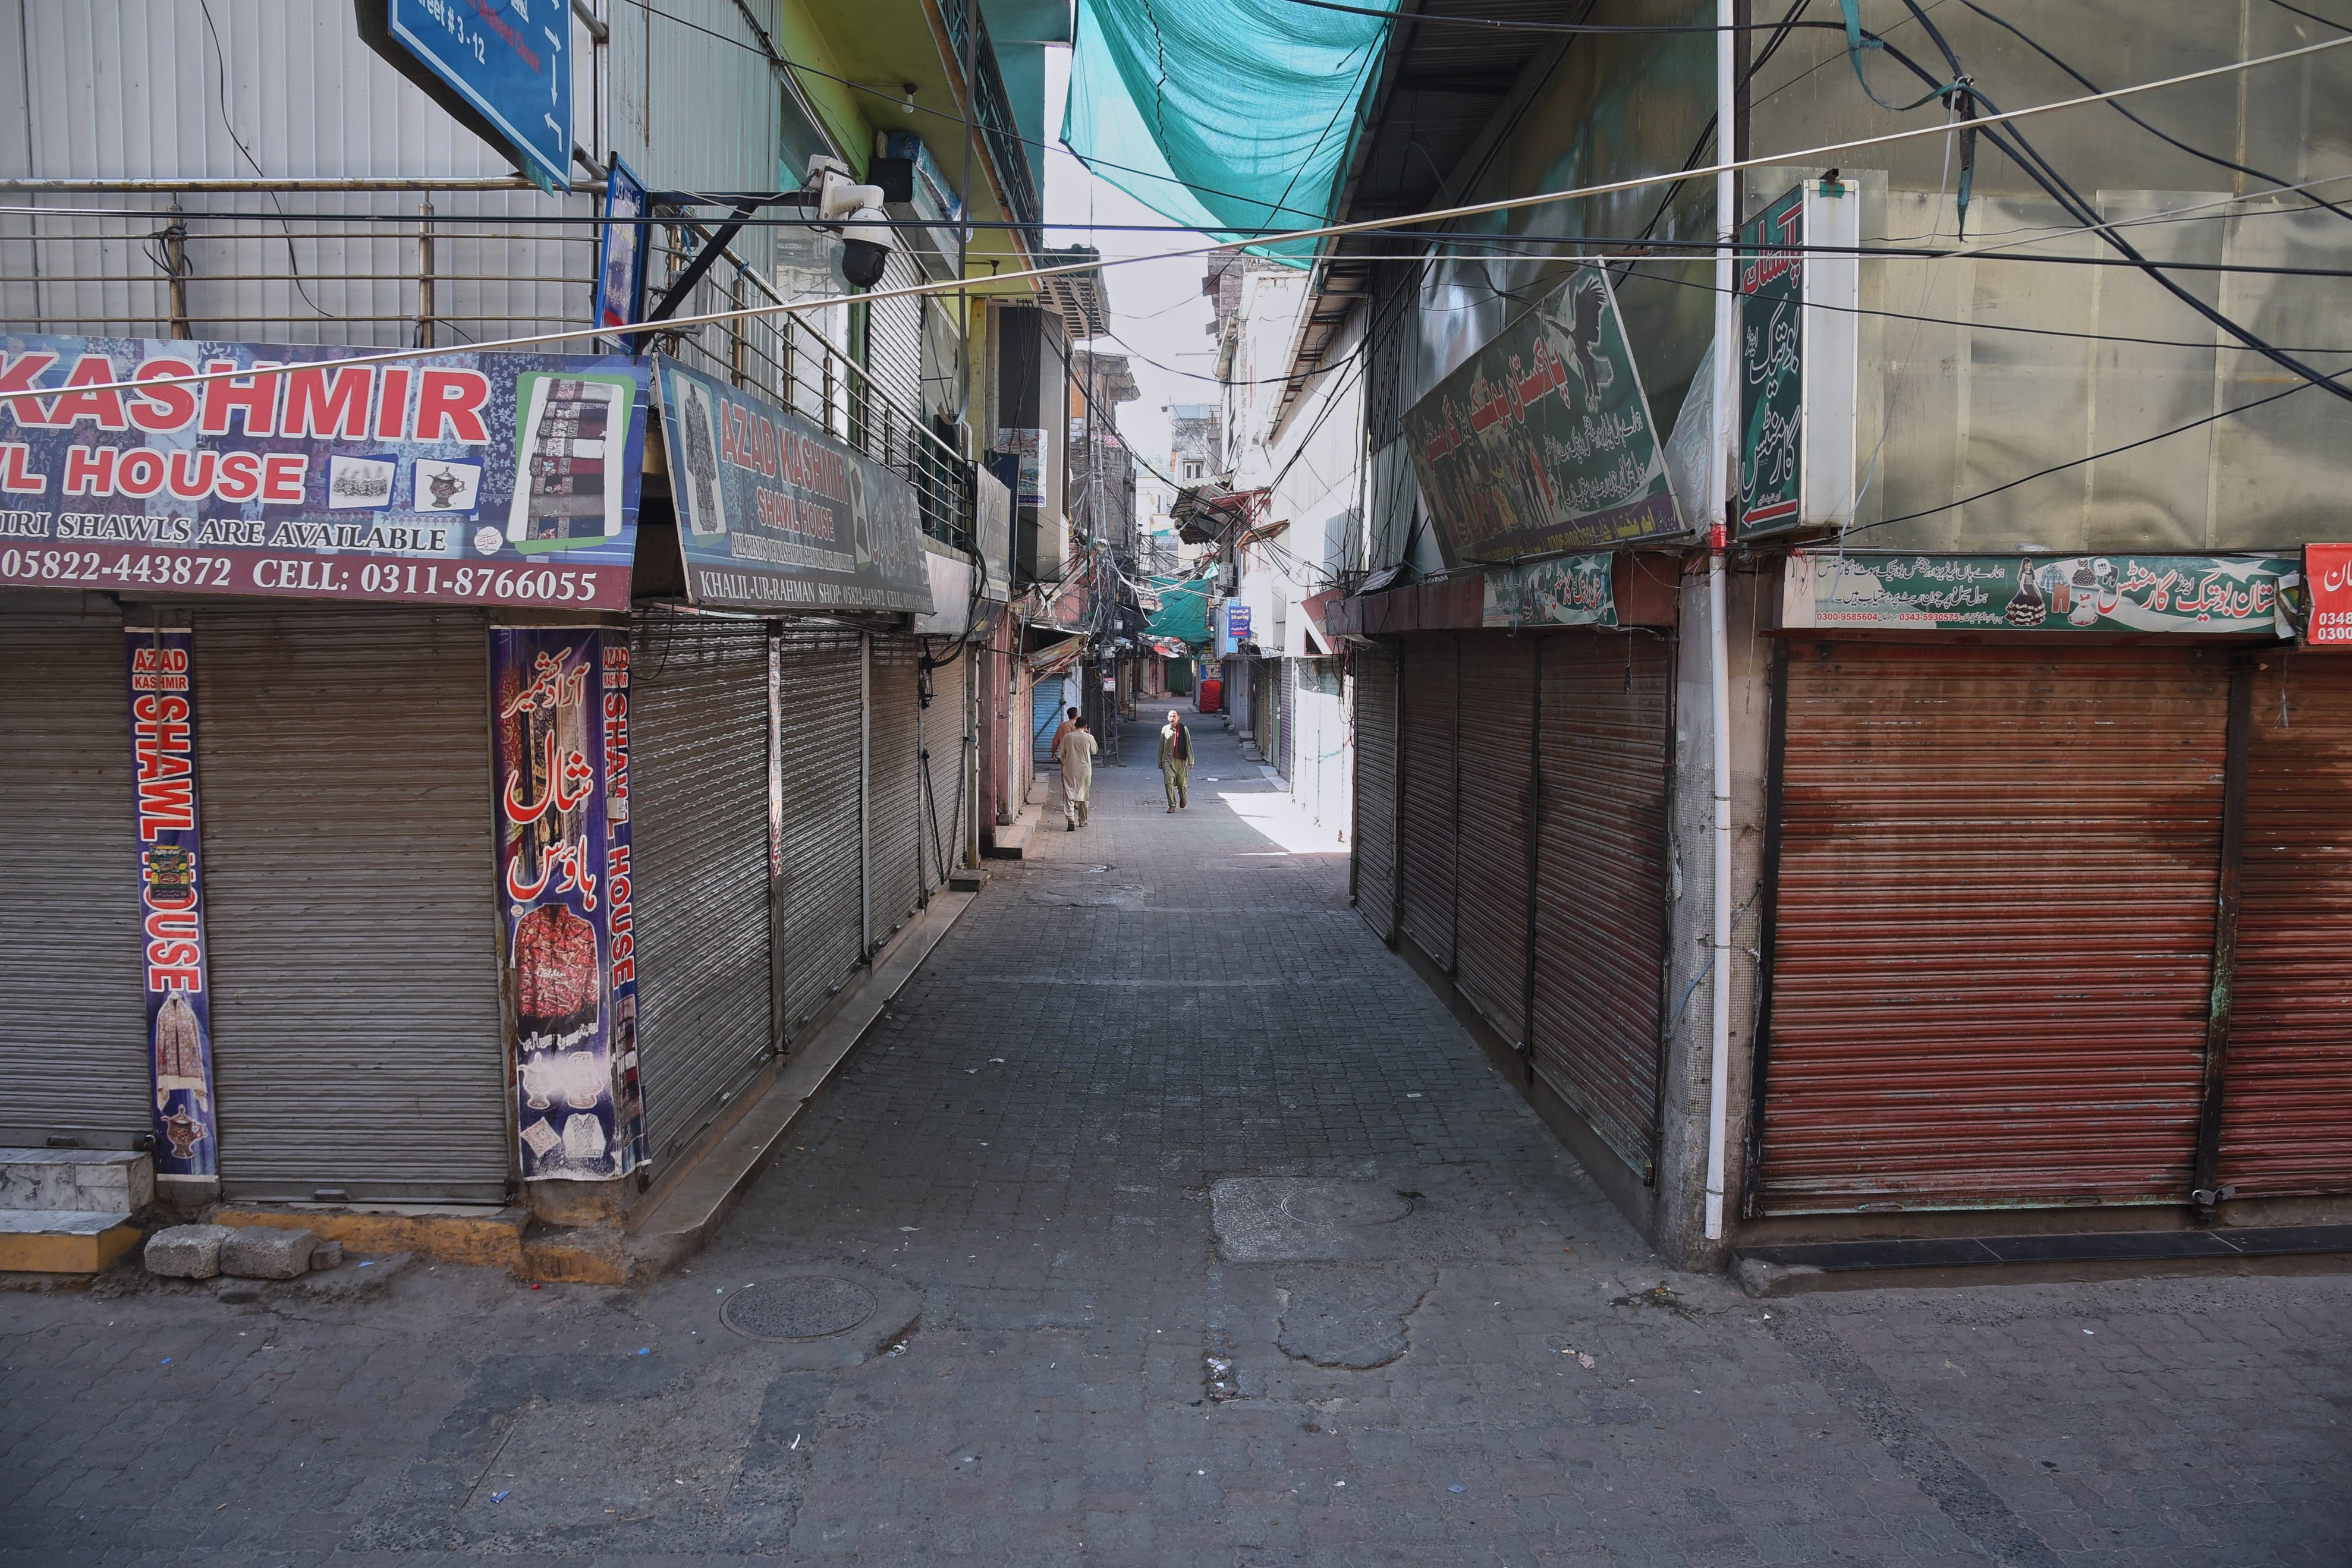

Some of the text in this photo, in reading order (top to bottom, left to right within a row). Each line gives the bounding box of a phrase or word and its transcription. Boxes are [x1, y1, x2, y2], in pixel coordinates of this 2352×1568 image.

[457, 15, 464, 43] 3
[472, 32, 485, 65] 12
[1750, 292, 1800, 398] بوتیک
[0, 350, 492, 445] KASHMIR
[1506, 335, 1571, 424] پاکستان
[721, 397, 848, 505] AZAD KASHMIR
[1741, 402, 1801, 503] گارمنٹس
[62, 445, 309, 505] HOUSE
[756, 486, 835, 541] SHAWL HOUSE
[57, 514, 192, 544] SHAWLS
[196, 518, 265, 546] ARE
[268, 521, 448, 553] AVAILABLE
[731, 531, 746, 559] ALL
[744, 534, 767, 561] KINDS
[766, 539, 776, 563] OF
[775, 540, 804, 567] KASHMIRI
[1, 548, 597, 602] 05822-443872 CELL: 0311-8766055
[699, 569, 815, 603] KHALIL-UR-RAHMAN
[818, 582, 843, 604] SHOP:
[843, 585, 885, 607] 05822-443872
[1853, 565, 1880, 576] سوٹ
[1876, 559, 1904, 581] بوتیک
[1956, 563, 1973, 583] ہاں
[1973, 565, 2005, 579] ہمارے
[2096, 559, 2177, 615] گارمنٹس
[2175, 573, 2195, 594] اینڈ
[1857, 588, 1892, 607] دستیاب
[1966, 585, 1989, 606] ہول
[2176, 571, 2233, 624] بوتیک
[1817, 612, 1878, 621] 0300-9585604
[1900, 612, 1960, 622] 0343-5930575
[2318, 627, 2352, 640] 0300
[132, 648, 188, 673] AZAD
[602, 646, 630, 671] AZAD
[132, 673, 189, 691] KASHMIR
[501, 646, 590, 719] آزاد کشمیر
[602, 672, 629, 689] KASHMIR
[133, 694, 194, 842] SHAWL
[504, 728, 594, 824] شال
[609, 844, 636, 990] HOUSE
